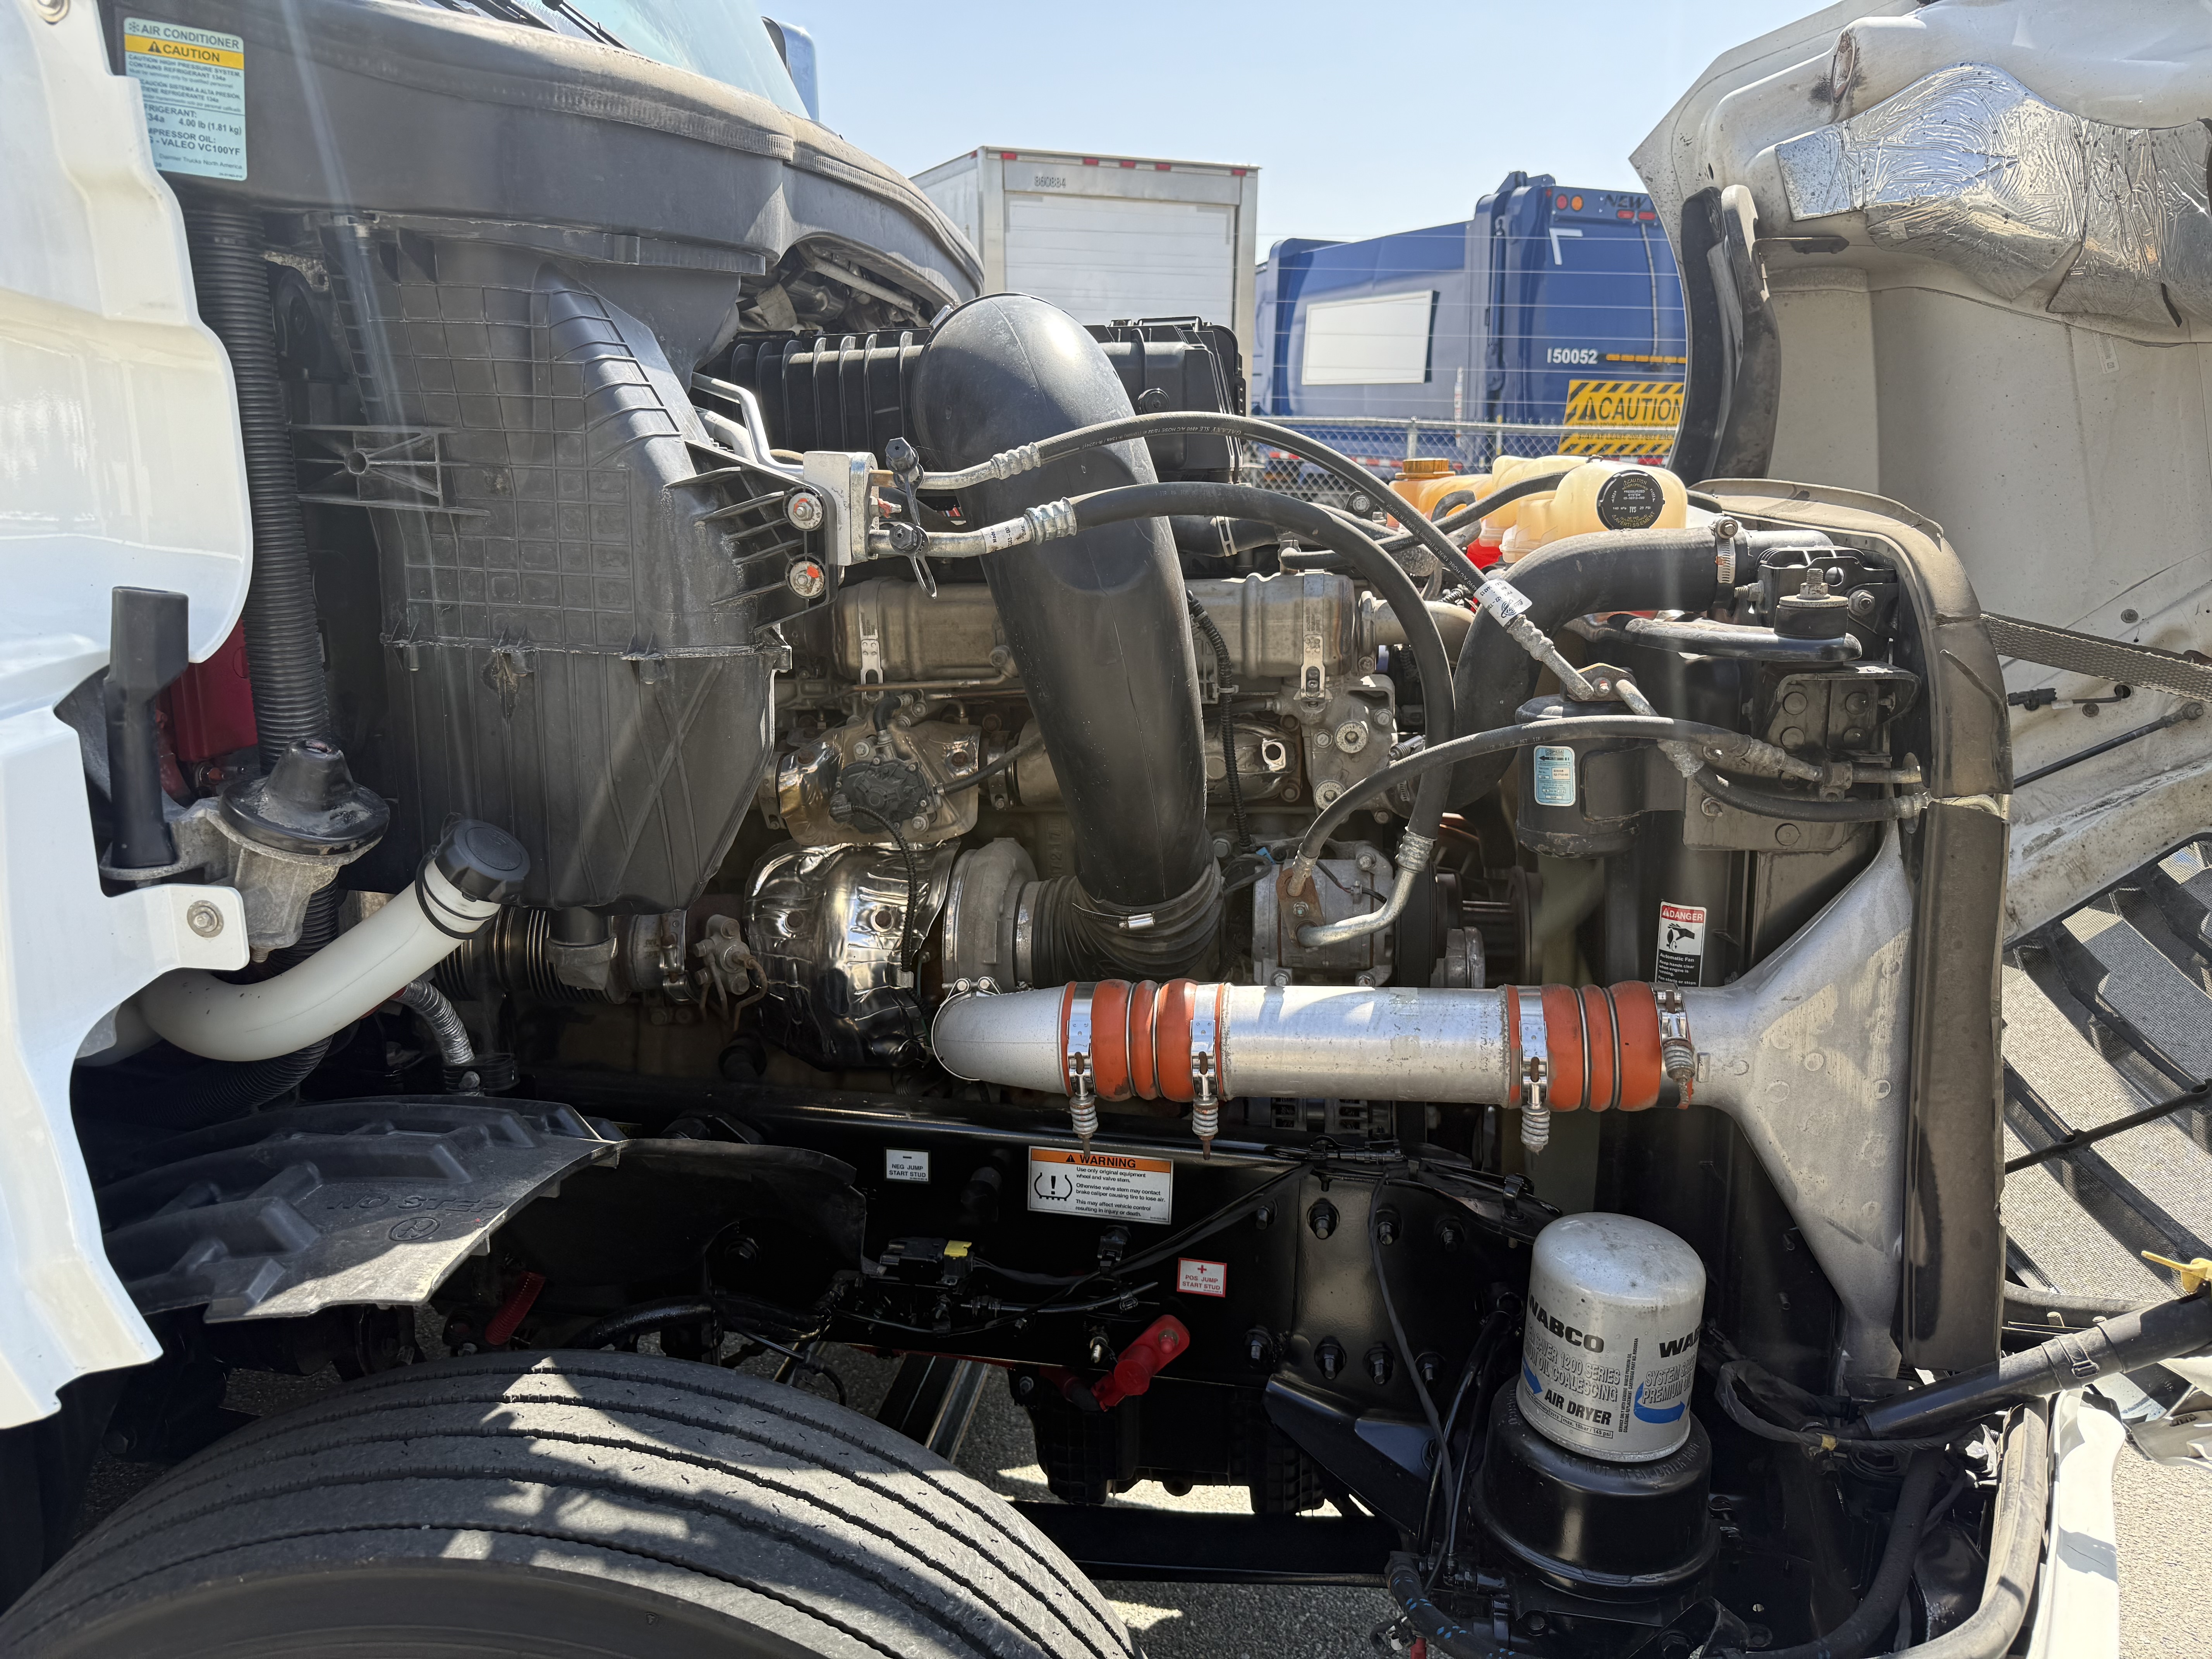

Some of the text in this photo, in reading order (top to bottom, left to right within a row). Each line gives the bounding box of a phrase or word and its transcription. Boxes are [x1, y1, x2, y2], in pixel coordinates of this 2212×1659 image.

[141, 25, 239, 49] AIR CONDITIONER
[163, 44, 220, 62] CAUTION
[129, 54, 158, 63] CAUTION
[177, 62, 213, 73] PRESSURE
[129, 61, 162, 71] CONTAINS
[163, 66, 210, 78] REFRIGERANT
[144, 103, 197, 118] FRIGERANT:
[148, 127, 196, 141] MPRESSOR
[198, 134, 216, 144] OIL:
[179, 118, 242, 136] 4.00 lb (1.81 kg)
[160, 137, 196, 150] VALEO
[198, 142, 240, 156] VC100YF
[1599, 397, 1680, 421] CAUTION
[1211, 426, 1242, 435] GALAXY
[1419, 532, 1436, 548] (10mm)
[1437, 550, 1449, 562] 13/32
[1448, 560, 1461, 574] HOSE
[1460, 572, 1468, 581] A/C
[1669, 910, 1703, 921] DANGER
[1659, 953, 1683, 961] Automatic
[1080, 1154, 1136, 1169] WARNING
[326, 1195, 504, 1213] NO STEP
[1659, 1323, 1700, 1358] WAB
[1536, 1333, 1558, 1364] SAVER
[1560, 1352, 1583, 1376] 1200
[1585, 1362, 1621, 1385] SERIES
[1539, 1356, 1550, 1377] OIL
[1552, 1365, 1618, 1402] COALESCING
[1645, 1364, 1681, 1387] SYSTEM
[1642, 1379, 1683, 1405] PREMIUM
[1544, 1388, 1565, 1410] AIR
[1566, 1400, 1612, 1426] DRYER
[1562, 1418, 1574, 1427] max.
[1575, 1423, 1589, 1432] 10bar
